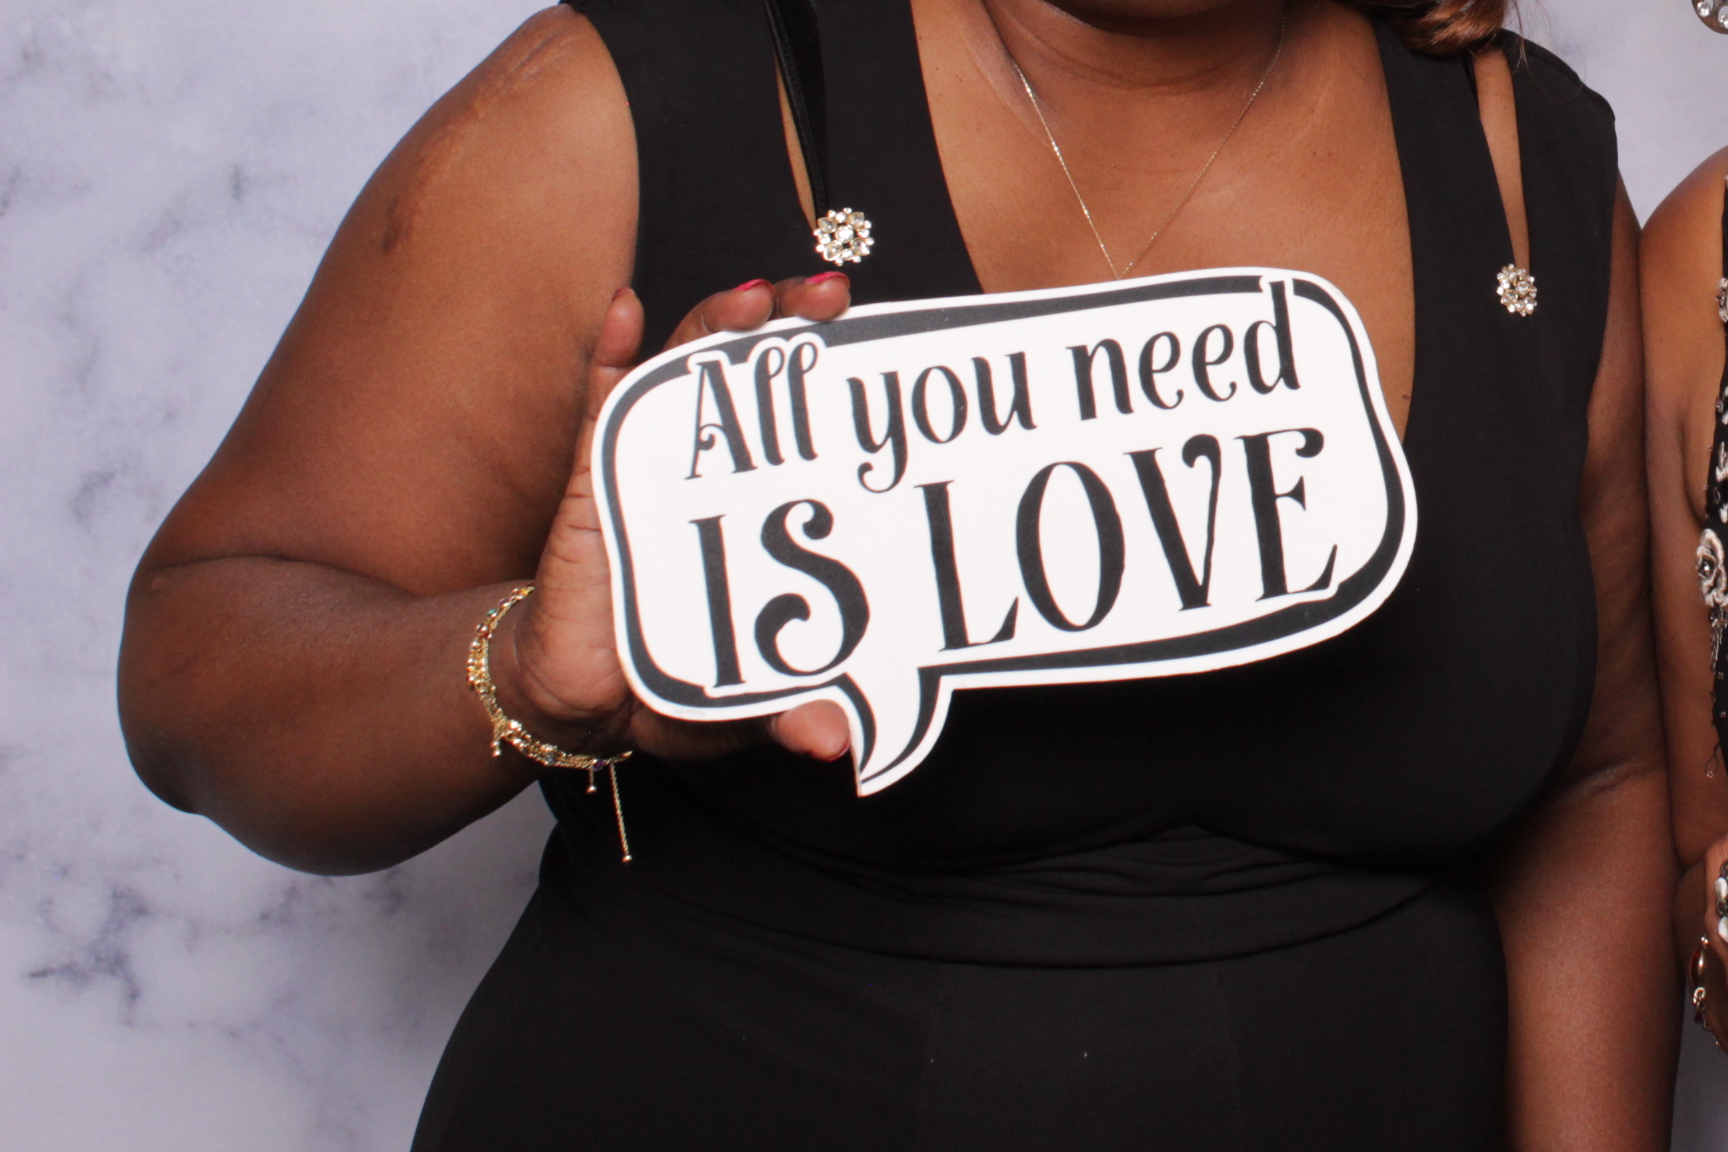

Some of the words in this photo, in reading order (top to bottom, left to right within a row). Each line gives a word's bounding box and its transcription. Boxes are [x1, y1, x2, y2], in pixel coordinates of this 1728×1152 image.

[684, 341, 821, 480] All
[846, 352, 1038, 494] you
[1066, 280, 1301, 420] need
[688, 498, 870, 688] IS
[913, 427, 1338, 652] LOVE
